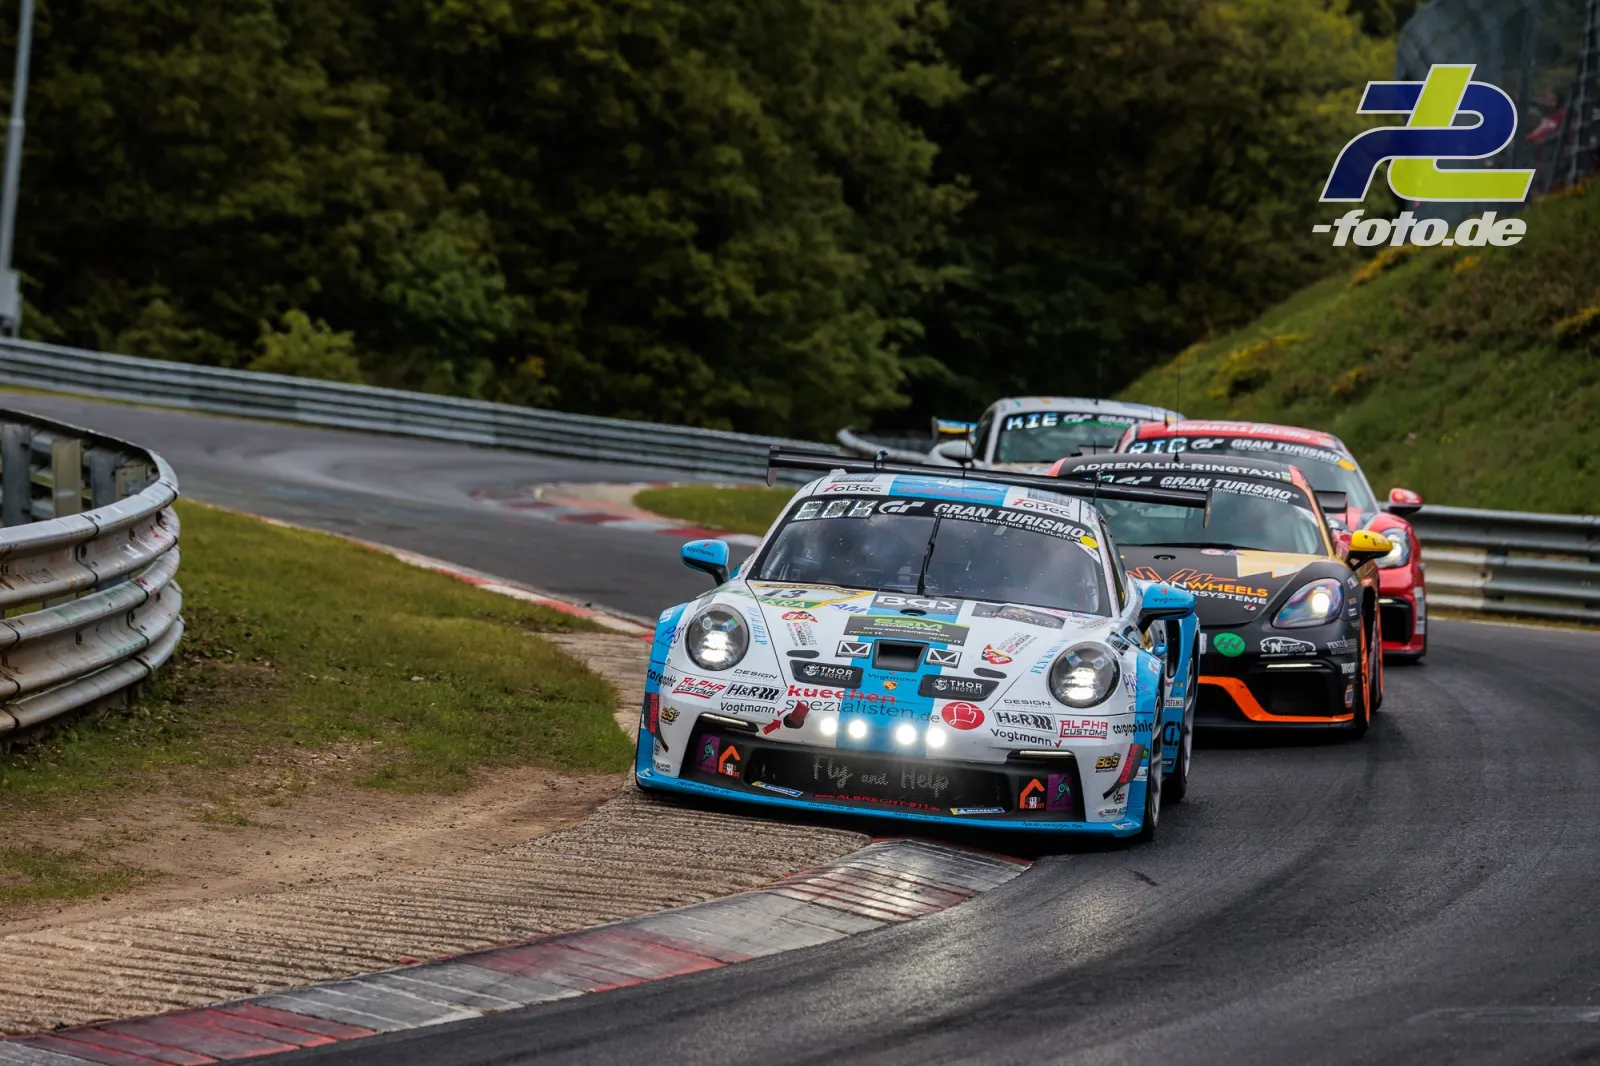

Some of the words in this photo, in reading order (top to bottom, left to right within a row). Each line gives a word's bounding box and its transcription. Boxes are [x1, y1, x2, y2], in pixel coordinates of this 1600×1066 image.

[1098, 415, 1134, 425] GRAN
[1230, 438, 1272, 450] GRAN
[1275, 441, 1341, 463] TURISMO
[1072, 460, 1281, 480] ADRENALIN-RINGTAXI
[1160, 475, 1210, 489] GRAN
[933, 503, 993, 518] GRAN
[954, 514, 981, 522] REAL
[983, 518, 1023, 529] DRIVING
[764, 589, 808, 599] 13
[1271, 642, 1306, 654] Neufeld
[734, 668, 778, 680] DESIGN
[820, 666, 854, 677] THOR
[820, 672, 852, 682] PROTECT
[867, 673, 918, 684] Vogtmann
[676, 685, 716, 698] CUSTOMS
[683, 677, 727, 692] ALPHA
[727, 684, 758, 698] H&R
[950, 679, 983, 690] THOR
[950, 685, 983, 694] PROTECT
[787, 685, 896, 705] kuechen
[720, 702, 776, 716] Vogtmann
[785, 699, 940, 723] spezialisten.de
[996, 712, 1031, 727] H&R
[1061, 720, 1109, 731] ALPHA
[990, 728, 1052, 747] Vogtmann
[1063, 728, 1108, 737] CUSTOMS
[1095, 754, 1119, 770] BBS
[812, 754, 853, 789] Fly
[860, 772, 889, 786] and
[900, 763, 949, 798] Help
[813, 793, 941, 812] www.ALBRECHT-911.de
